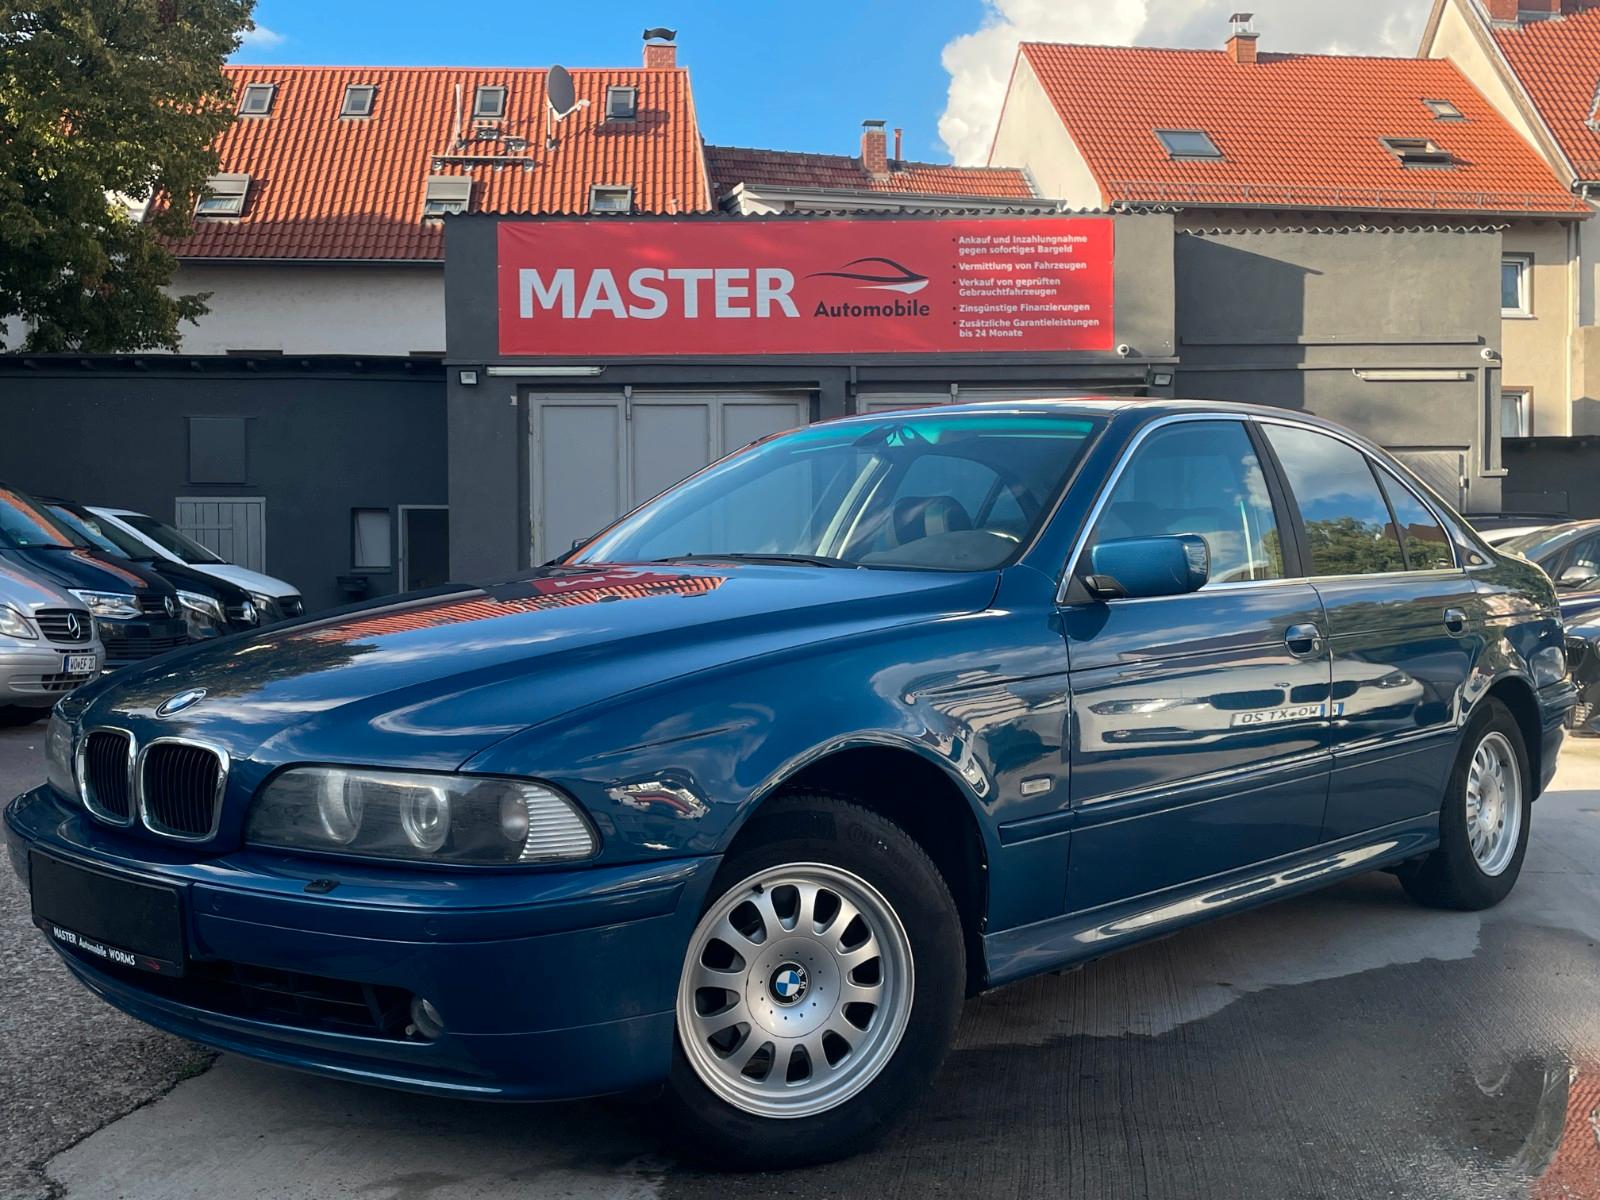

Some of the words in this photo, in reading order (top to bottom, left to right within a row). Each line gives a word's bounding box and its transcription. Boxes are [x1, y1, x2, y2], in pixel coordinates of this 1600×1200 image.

[958, 236, 991, 245] Ankauf
[993, 236, 1011, 244] und
[1013, 234, 1088, 244] Inzahlungnahme
[958, 247, 987, 256] gegen
[989, 246, 1035, 256] sofortiges
[1037, 245, 1073, 255] Bargeld
[958, 261, 1013, 272] Vermittlung
[1034, 261, 1087, 271] Fahrzeugen
[959, 278, 994, 287] Verkauf
[996, 279, 1013, 287] von
[1015, 277, 1061, 288] geprüften
[518, 267, 801, 320] MASTER
[959, 287, 1057, 298] Gebrauchtfahrzeugen
[814, 300, 930, 318] Automobile
[959, 304, 1018, 313] Zinsgünstige
[1020, 303, 1090, 313] Finanzierungen
[959, 319, 1011, 328] Zusätzliche
[1013, 318, 1100, 328] Garantieleistungen
[959, 329, 973, 338] bis
[975, 329, 987, 337] 24
[989, 329, 1023, 337] Monate
[53, 926, 77, 944] MASTER
[79, 937, 107, 957] Automobile
[108, 948, 136, 966] WORMS
